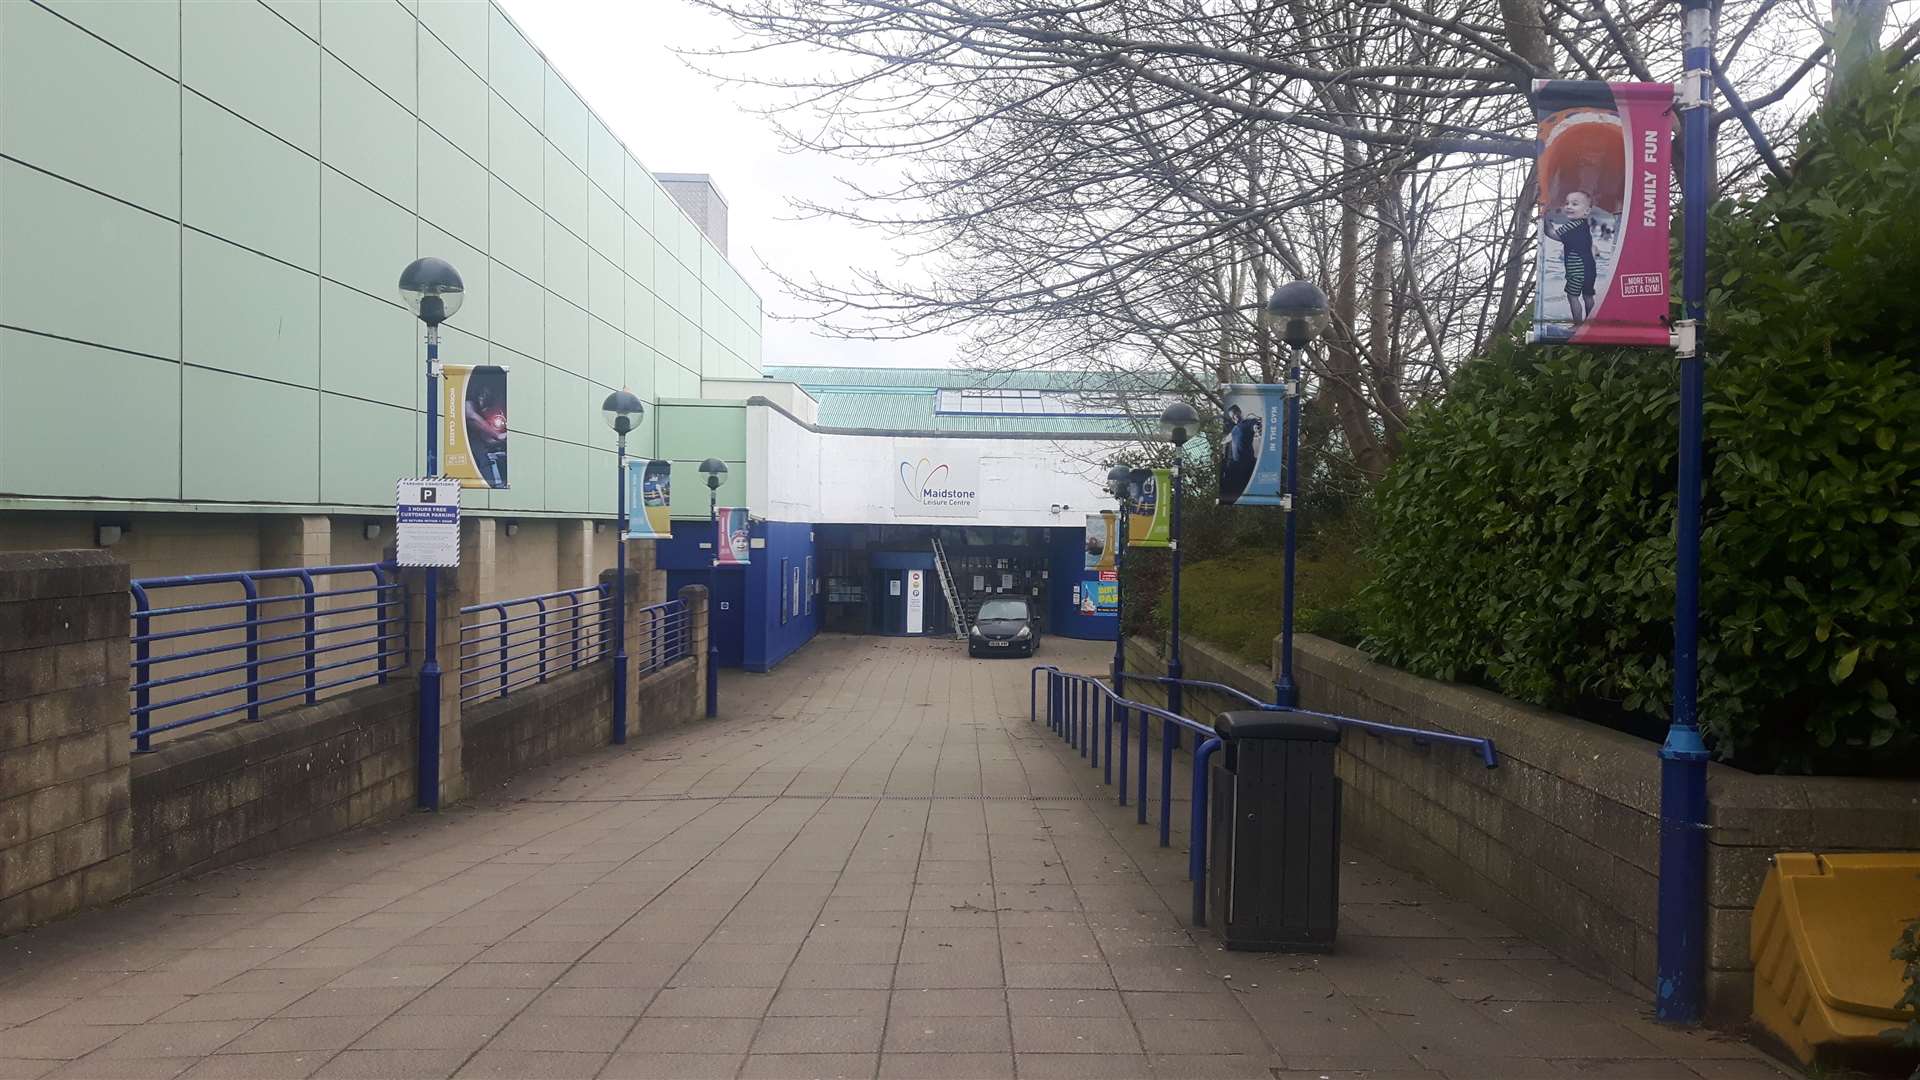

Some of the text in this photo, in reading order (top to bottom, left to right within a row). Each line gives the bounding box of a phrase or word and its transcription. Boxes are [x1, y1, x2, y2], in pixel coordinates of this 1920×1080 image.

[1643, 130, 1658, 228] FAMILY FUN
[1645, 275, 1660, 284] THAN
[1624, 284, 1661, 294] JUST A GYM!
[1271, 406, 1279, 423] GYM
[1269, 443, 1277, 452] IN
[424, 490, 433, 501] P
[923, 489, 976, 498] Maidstone
